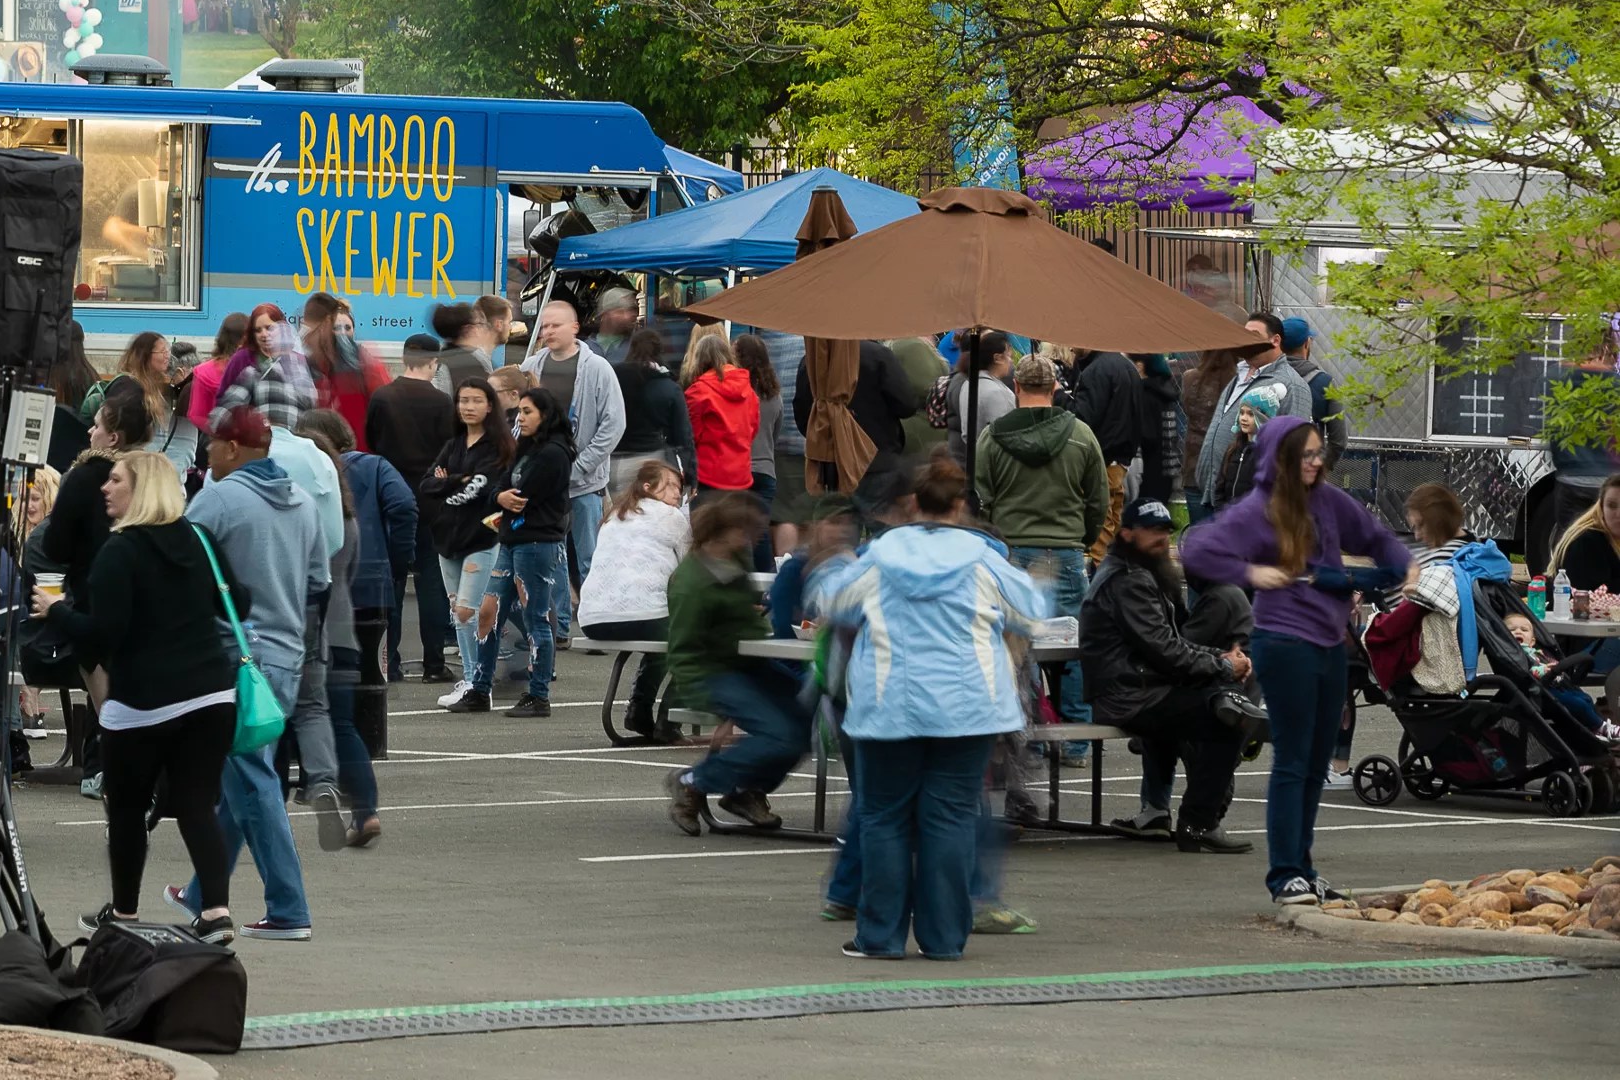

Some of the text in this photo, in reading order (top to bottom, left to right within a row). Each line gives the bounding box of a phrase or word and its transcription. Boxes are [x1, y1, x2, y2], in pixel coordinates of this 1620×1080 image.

[245, 110, 456, 202] the BAMBOO
[17, 256, 44, 266] QSC
[292, 207, 457, 300] SKEWER
[371, 315, 414, 328] street
